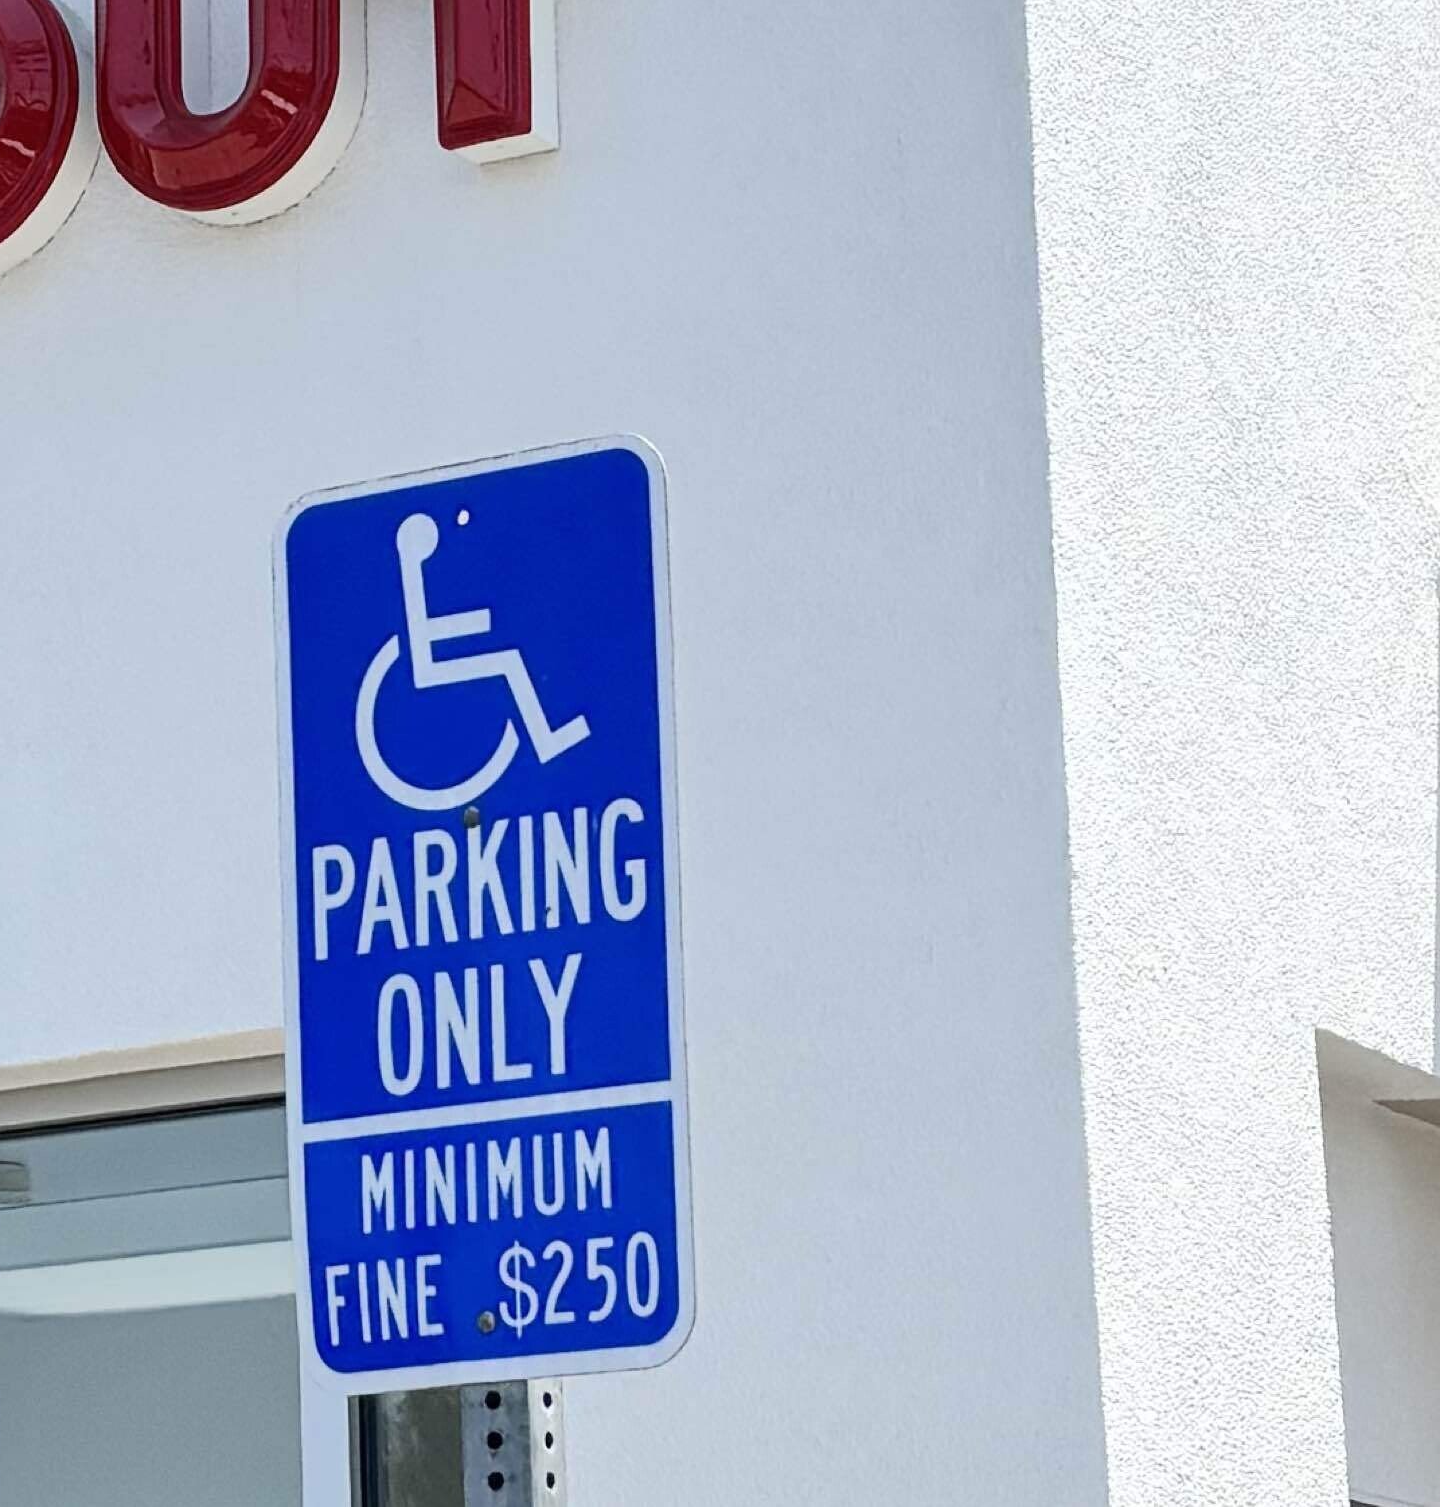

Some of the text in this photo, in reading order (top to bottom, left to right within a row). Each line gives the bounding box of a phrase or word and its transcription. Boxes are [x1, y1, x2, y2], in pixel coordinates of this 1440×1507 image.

[311, 797, 647, 961] PARKING
[376, 953, 583, 1097] ONLY
[360, 1126, 613, 1235] MINIMUM
[324, 1229, 661, 1348] FINE $250
